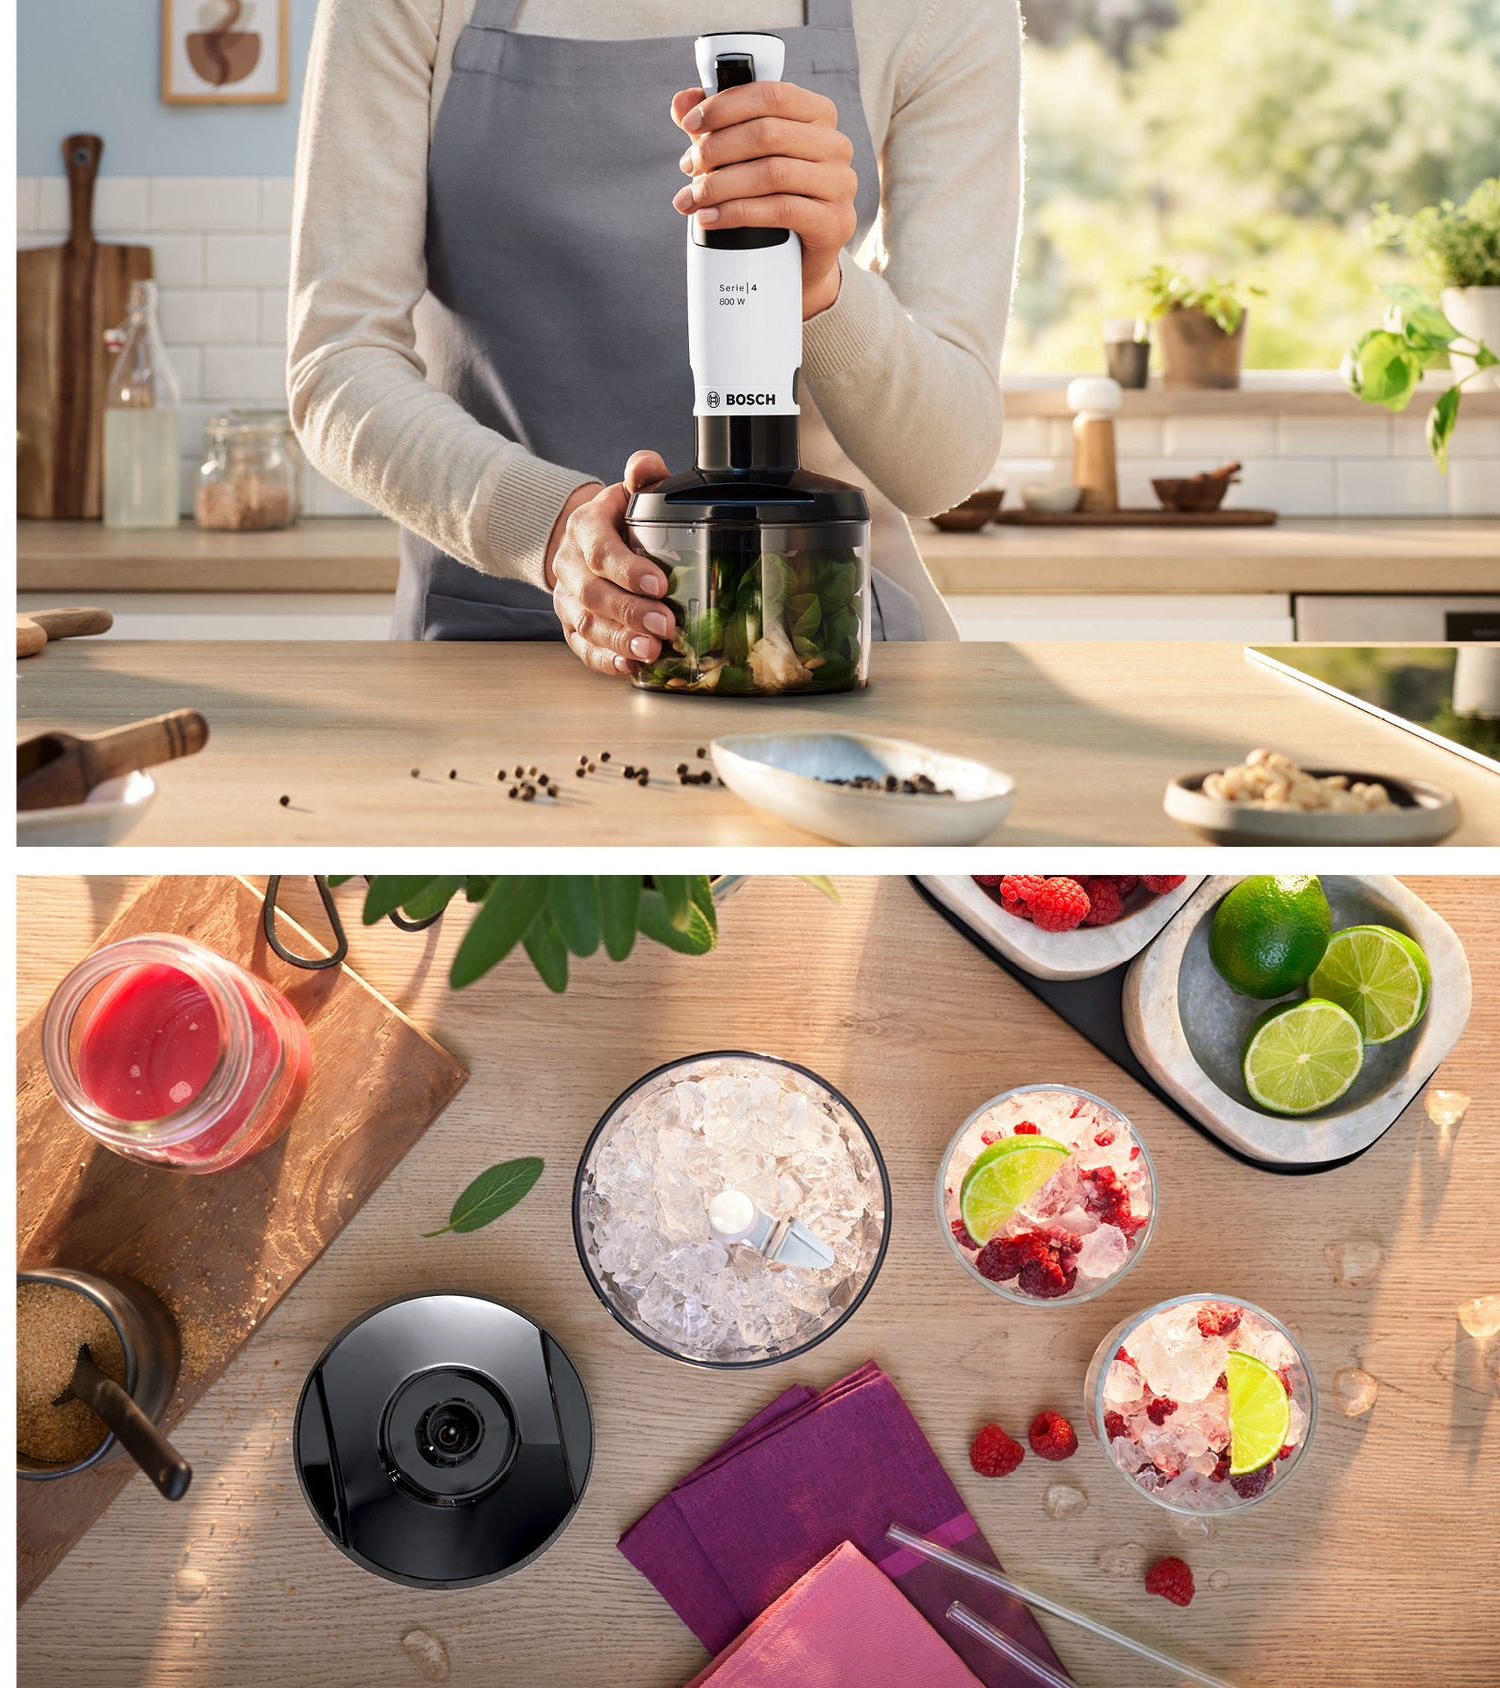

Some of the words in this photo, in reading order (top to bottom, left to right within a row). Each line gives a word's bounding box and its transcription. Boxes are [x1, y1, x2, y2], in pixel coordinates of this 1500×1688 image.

[719, 297, 735, 306] 800
[736, 297, 746, 305] W
[726, 394, 776, 406] BOSCH
